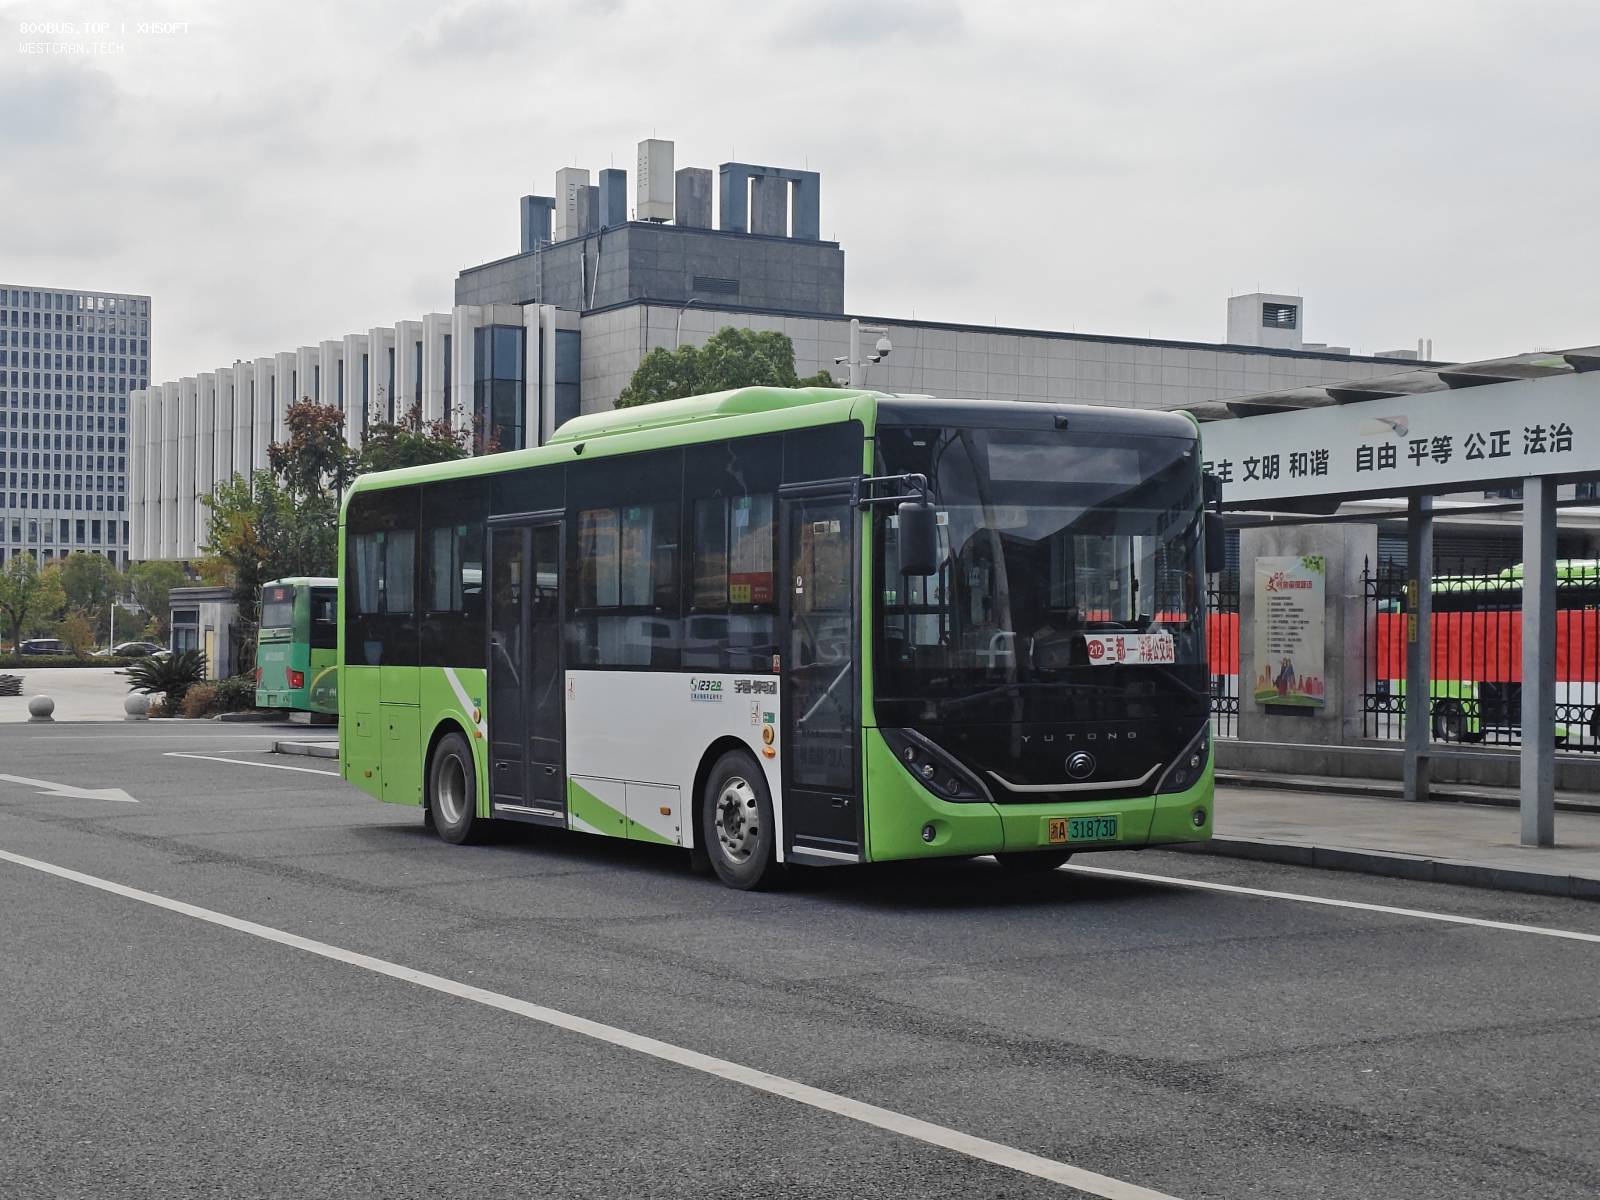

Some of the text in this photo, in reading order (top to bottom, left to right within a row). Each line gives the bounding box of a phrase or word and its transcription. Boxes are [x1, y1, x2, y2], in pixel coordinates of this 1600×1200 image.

[1242, 454, 1280, 483] 文明
[1289, 449, 1329, 479] 和谐
[1356, 441, 1397, 473] 自由
[1407, 434, 1454, 467] 平等
[1463, 429, 1511, 462] 公正
[1523, 422, 1574, 455] 法治
[1022, 731, 1137, 743] YUTONG
